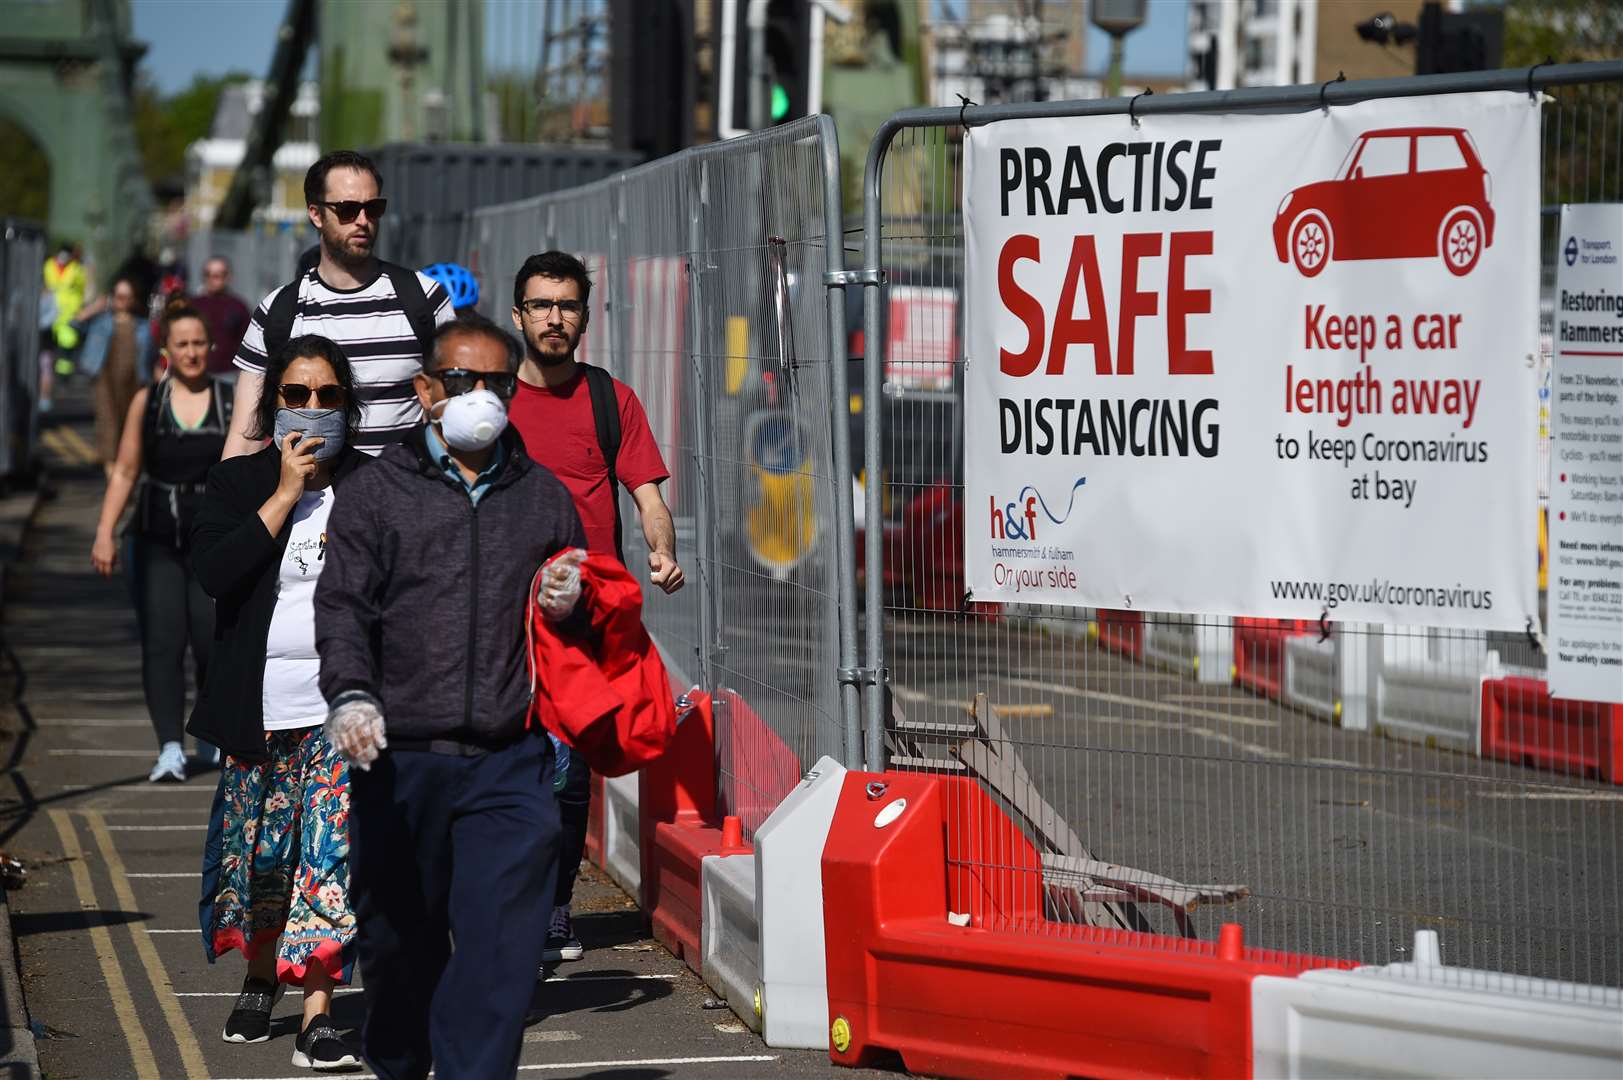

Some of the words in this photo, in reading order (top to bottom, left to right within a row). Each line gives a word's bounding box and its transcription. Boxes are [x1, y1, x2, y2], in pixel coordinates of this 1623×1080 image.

[1000, 140, 1222, 216] PRACTISE
[1582, 239, 1611, 250] Transport
[1591, 254, 1617, 264] London
[998, 231, 1215, 377] SAFE
[1561, 288, 1623, 318] Restoring
[1305, 304, 1377, 363] Keep
[1385, 314, 1402, 350] a
[1413, 313, 1462, 350] car
[1286, 364, 1382, 427] length
[1391, 378, 1481, 429] away
[998, 398, 1219, 458] DISTANCING
[1276, 433, 1299, 460] to
[1309, 430, 1357, 468] keep
[1362, 432, 1488, 463] Coronavirus
[1351, 473, 1369, 500] at
[1376, 470, 1417, 508] bay
[990, 495, 1036, 541] h&f
[992, 545, 1040, 558] hammersmith
[1041, 547, 1047, 559] &
[1048, 547, 1074, 560] fulham
[994, 563, 1013, 586] On
[1016, 567, 1044, 592] your
[1048, 566, 1077, 589] side
[1271, 579, 1493, 610] www.gov.uk/coronavirus
